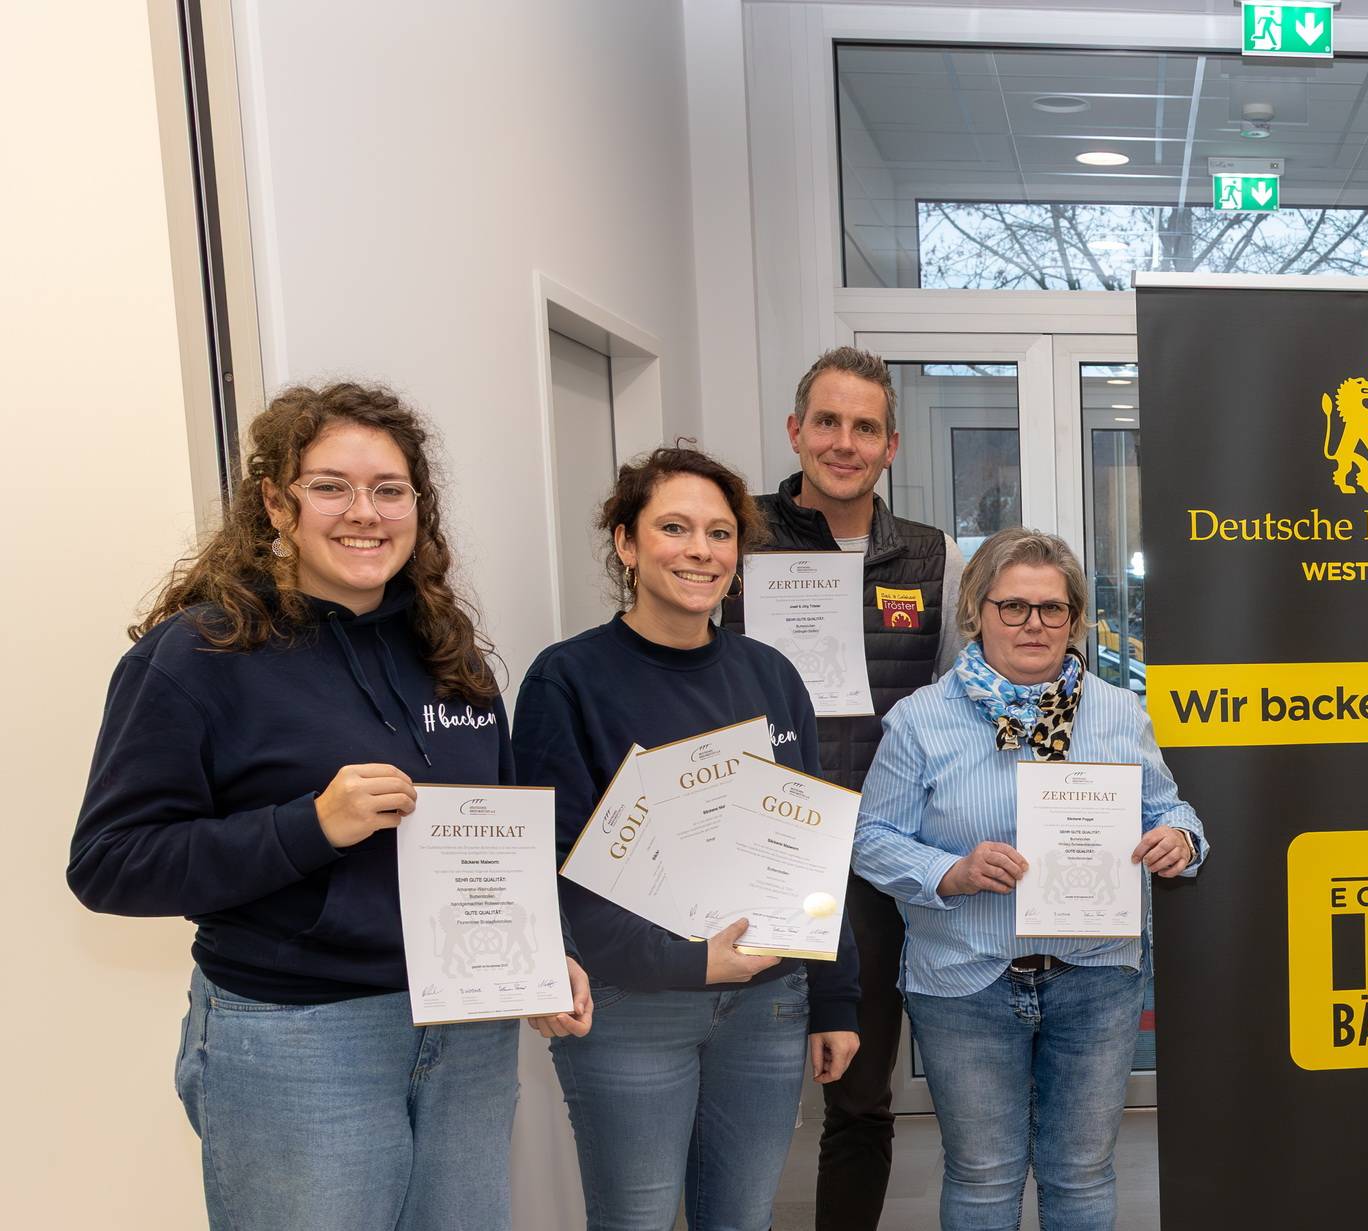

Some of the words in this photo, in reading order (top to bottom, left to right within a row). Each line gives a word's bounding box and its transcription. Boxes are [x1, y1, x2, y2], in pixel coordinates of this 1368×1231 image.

[1187, 508, 1354, 542] Deutsche
[768, 579, 840, 590] ZERTIFIKAT
[884, 600, 915, 610] Tröster
[1169, 688, 1248, 724] Wir
[1042, 790, 1117, 802] ZERTIFIKAT
[762, 795, 822, 827] GOLD
[431, 824, 526, 838] ZERTIFIKAT
